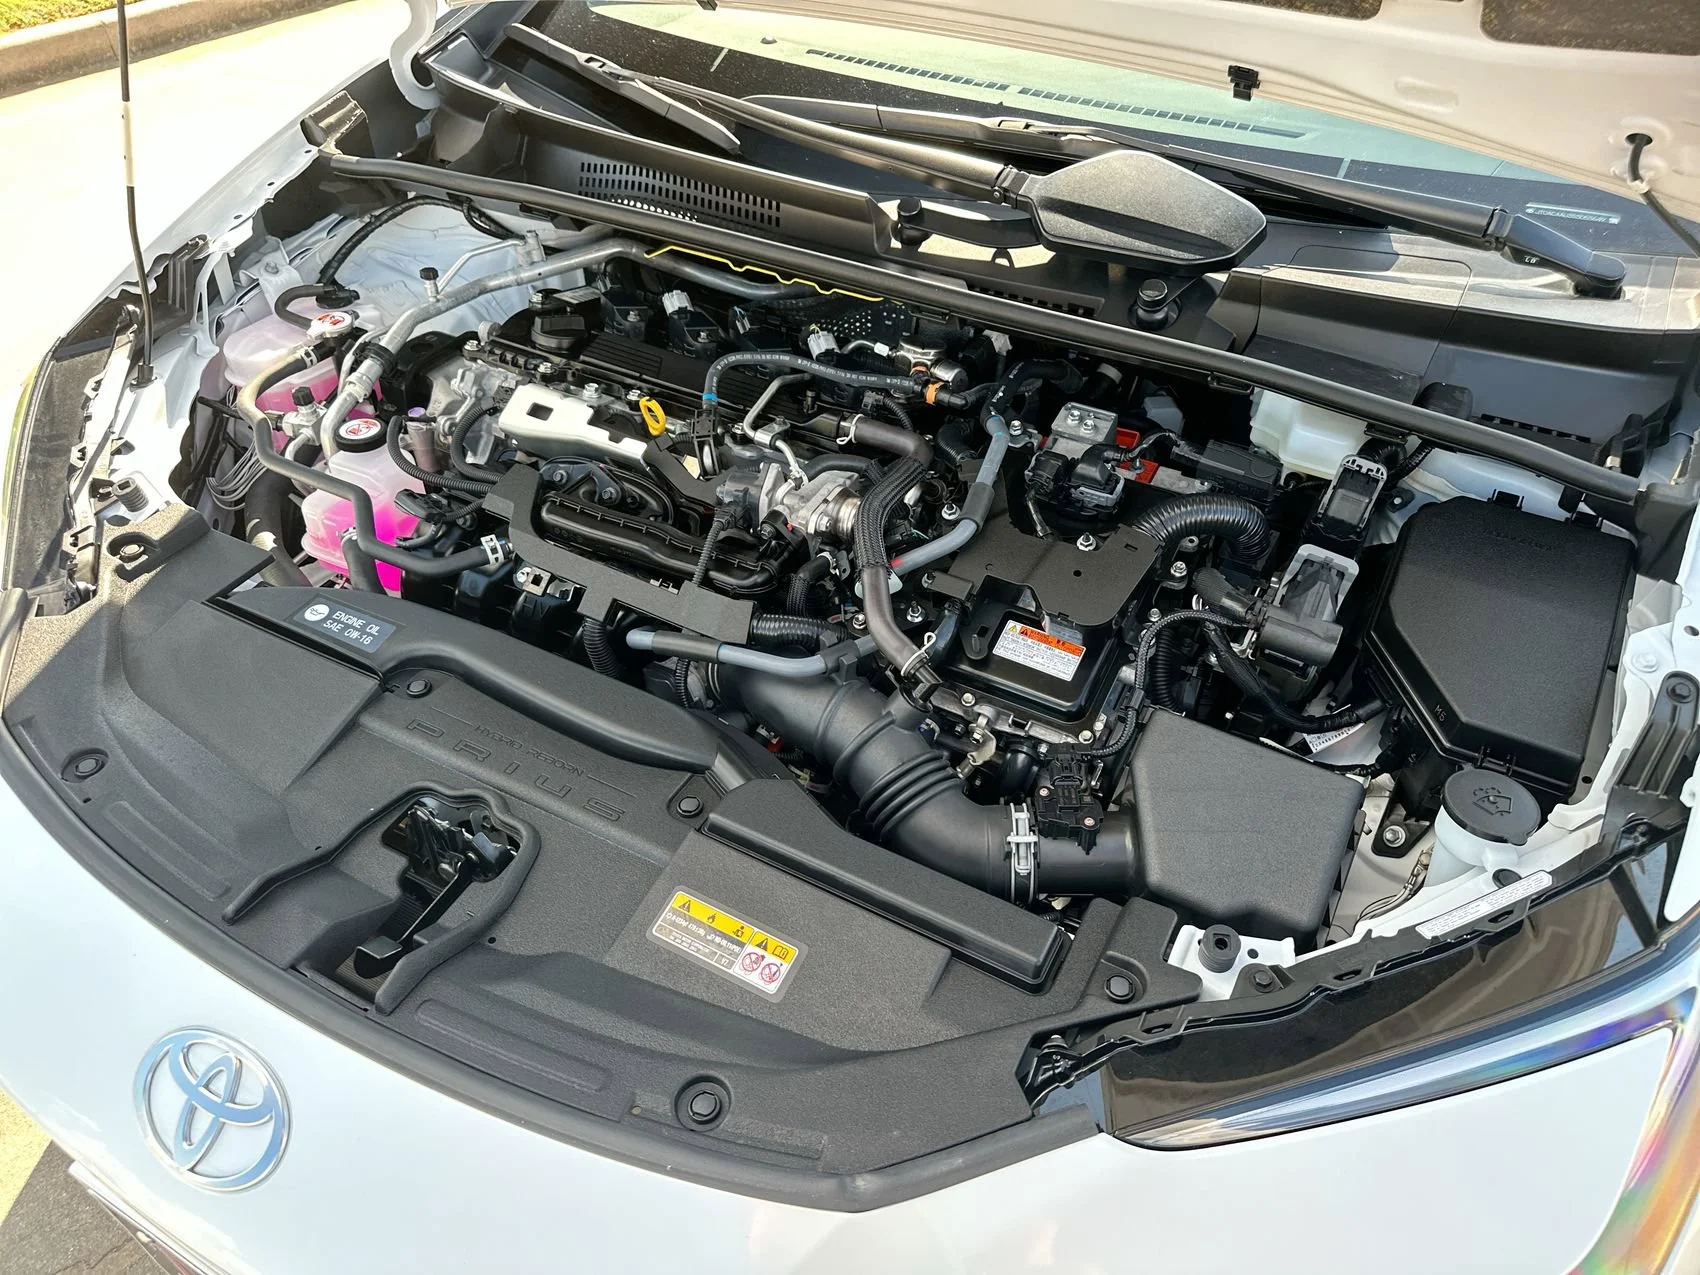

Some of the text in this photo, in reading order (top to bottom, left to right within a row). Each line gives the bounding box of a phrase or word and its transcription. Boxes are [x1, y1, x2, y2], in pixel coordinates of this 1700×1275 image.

[323, 620, 374, 645] SAE 0W-16
[332, 610, 380, 636] ENGINE OIL
[407, 718, 626, 822] PRIUS
[474, 724, 586, 777] HYBRID REBORN
